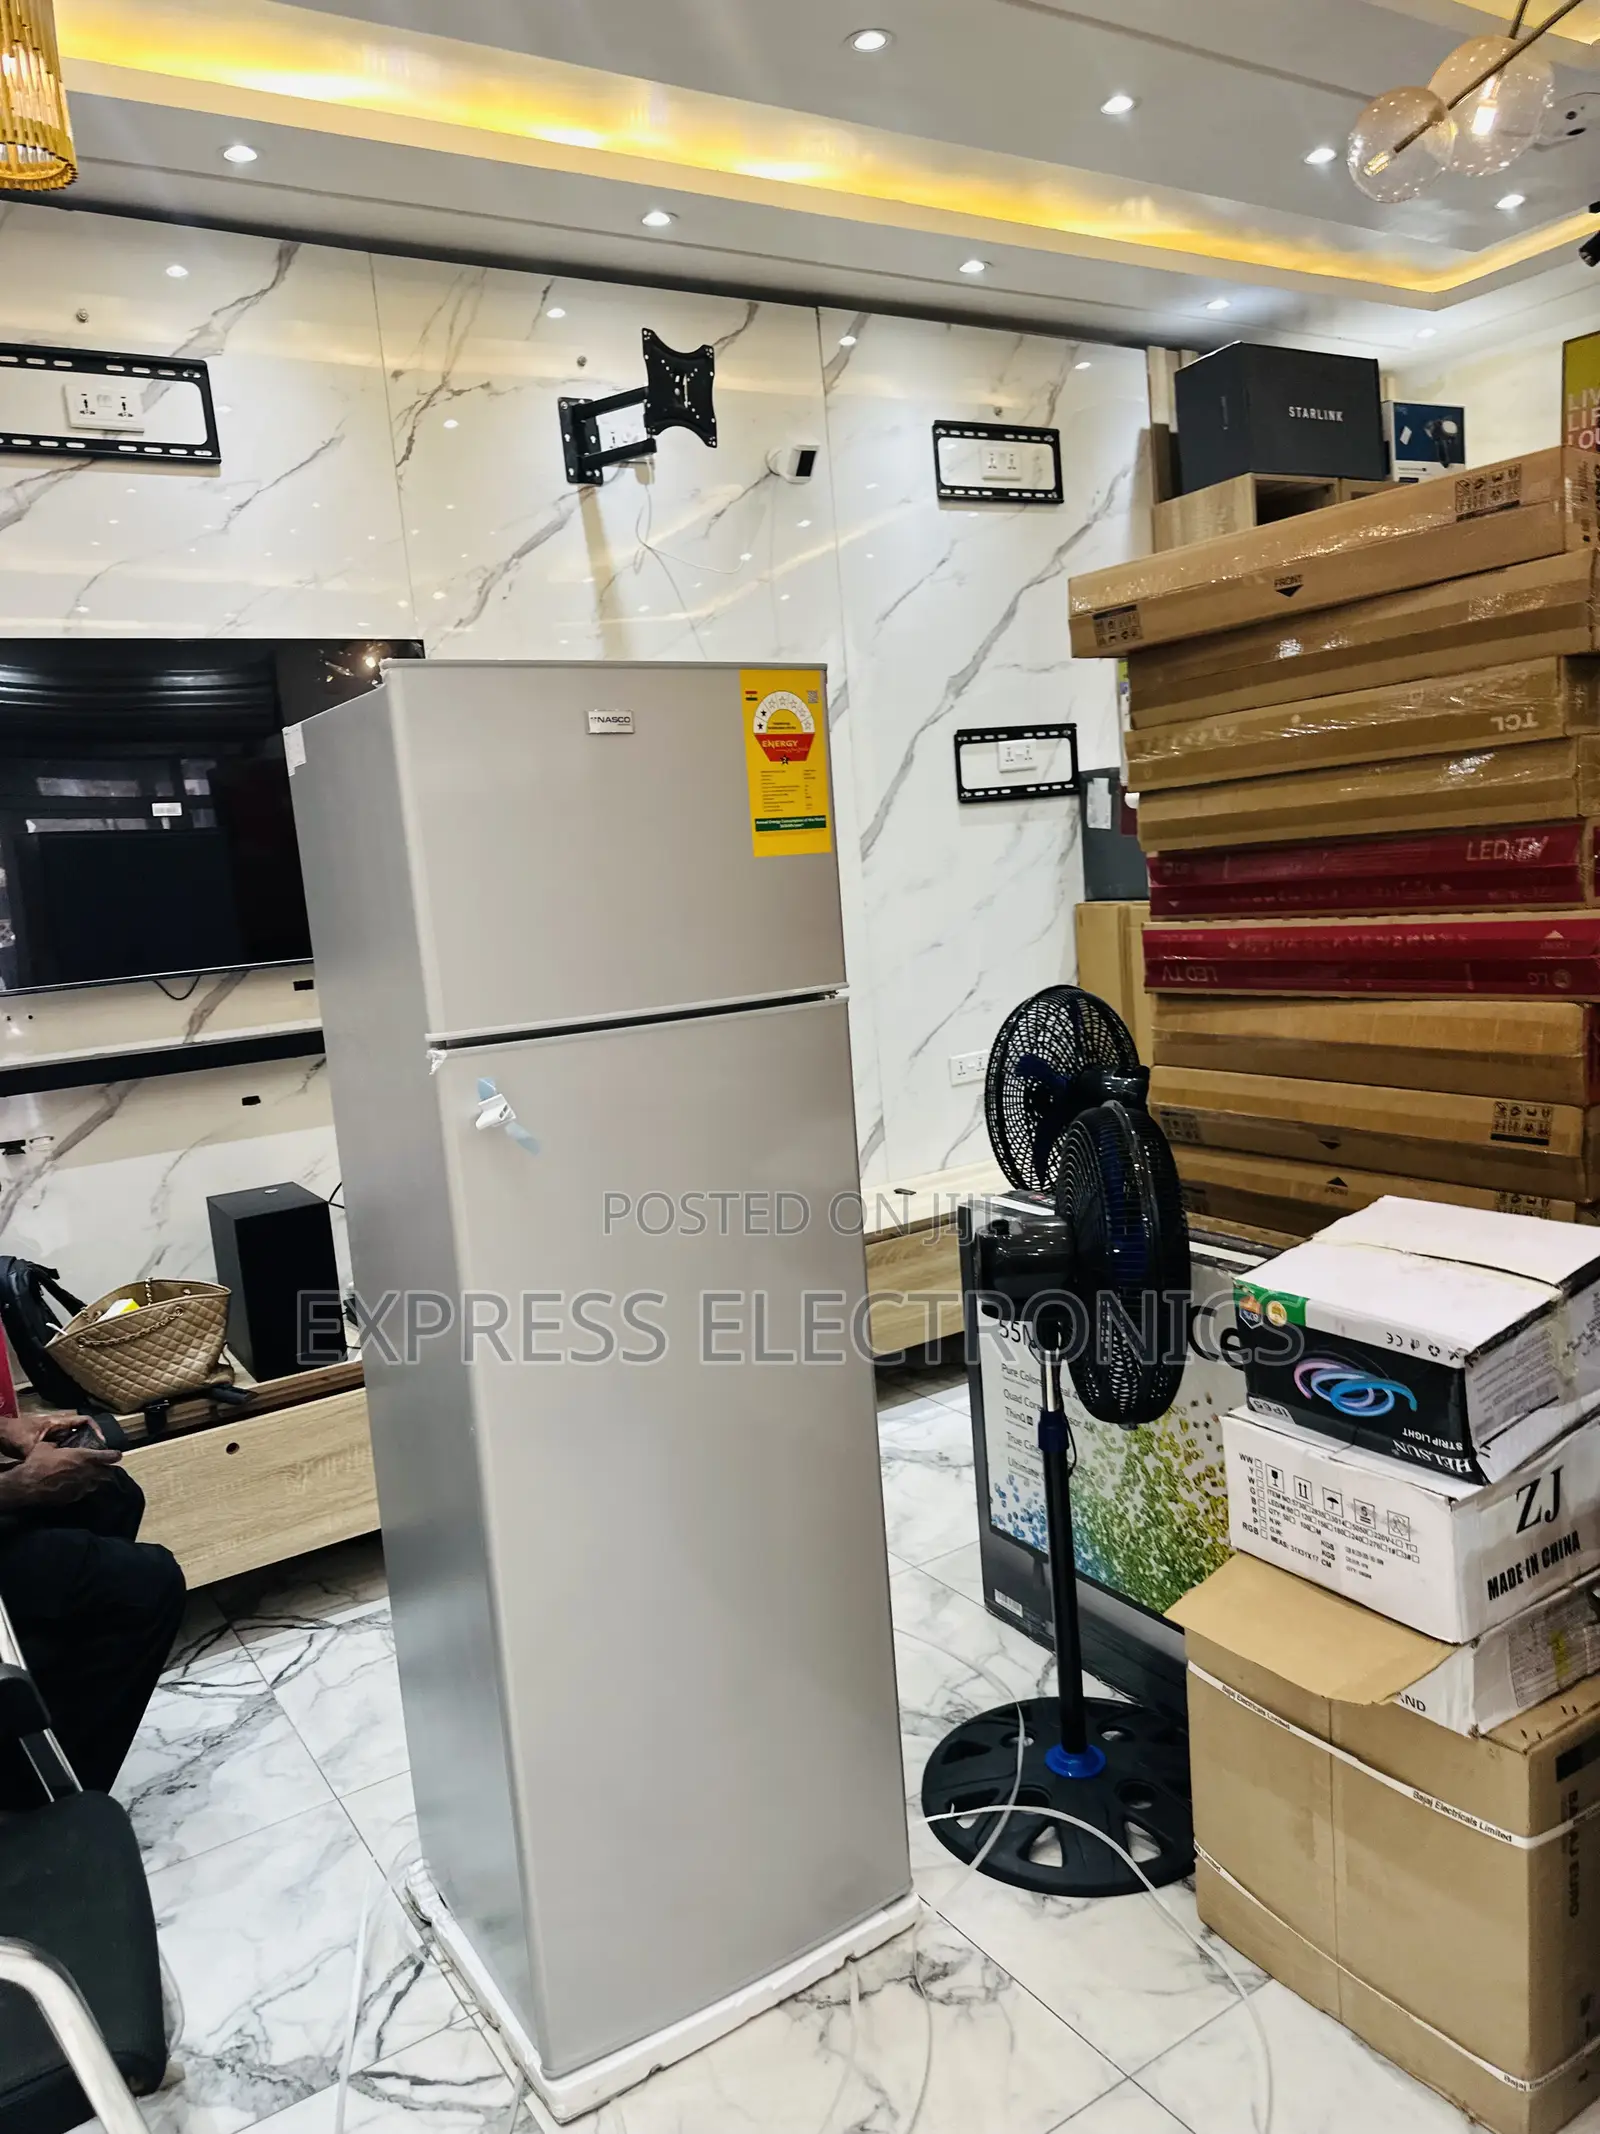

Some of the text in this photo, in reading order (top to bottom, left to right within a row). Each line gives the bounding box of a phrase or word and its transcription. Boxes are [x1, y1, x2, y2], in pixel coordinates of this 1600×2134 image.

[1288, 406, 1343, 422] STARLINK
[1490, 712, 1539, 732] TCL
[762, 739, 799, 749] ENERGY
[1466, 838, 1509, 861] LED
[1162, 965, 1218, 983] LED TV
[1001, 1363, 1018, 1377] Pure
[1003, 1388, 1022, 1404] Quad
[1253, 1400, 1289, 1418] IP65
[1006, 1431, 1022, 1446] True
[1402, 1427, 1463, 1451] STRIP LIGHT
[1239, 1452, 1253, 1464] WW
[1393, 1439, 1473, 1473] HELSUN
[1251, 1496, 1257, 1505] B
[1516, 1464, 1564, 1534] ZJ
[1252, 1507, 1258, 1515] R
[1242, 1522, 1259, 1535] RGB
[1321, 1540, 1334, 1551] KGS
[1321, 1550, 1335, 1561] KGS
[1321, 1559, 1332, 1568] CM
[1487, 1530, 1581, 1600] MADE IN CHINA
[1413, 1790, 1513, 1842] Bajaj Electricals Limited
[1504, 2075, 1526, 2091] Bajaj
